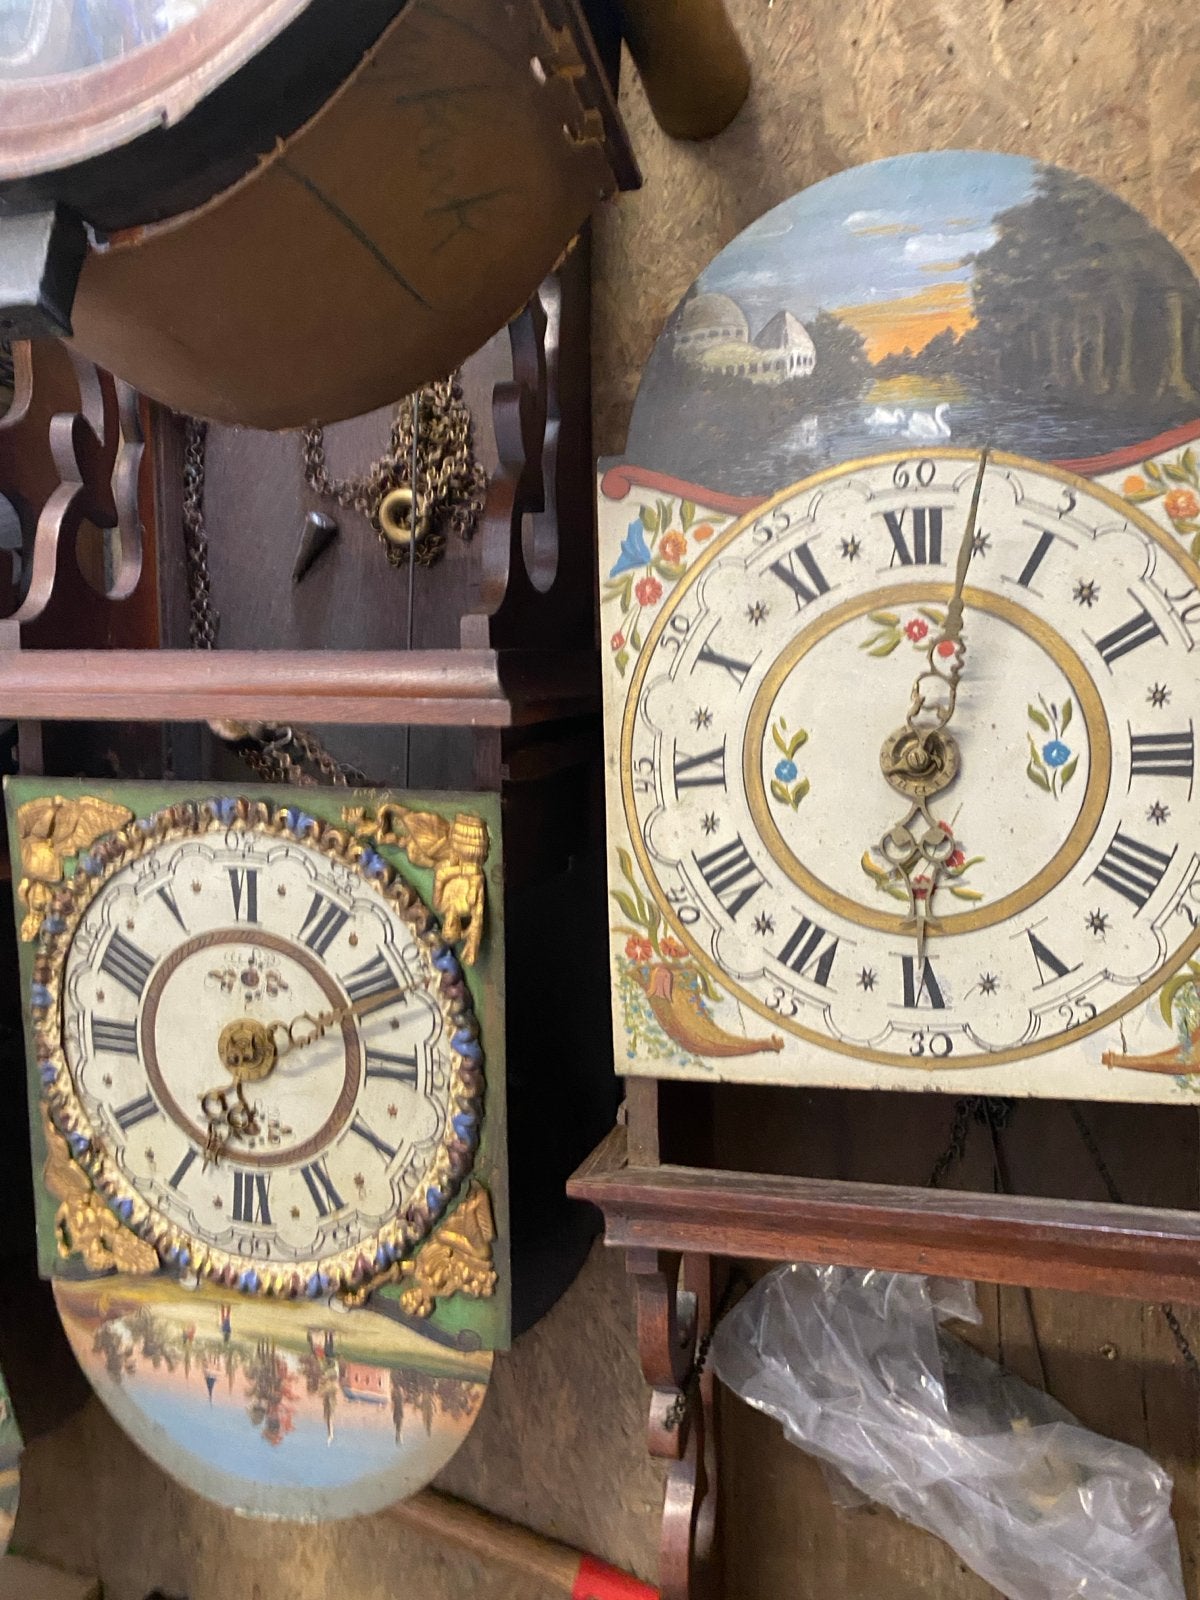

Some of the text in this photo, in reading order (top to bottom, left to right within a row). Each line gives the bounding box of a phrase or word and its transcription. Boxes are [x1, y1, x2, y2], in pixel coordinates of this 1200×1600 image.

[893, 459, 937, 489] 60
[752, 509, 791, 543] 55
[872, 506, 954, 573] XII
[759, 531, 841, 613] XI
[661, 614, 690, 650] 50
[690, 617, 762, 692] X
[1082, 588, 1168, 676] II
[634, 757, 655, 794] 45
[673, 733, 727, 801] IX
[1127, 718, 1194, 802] III
[692, 831, 773, 922] VIII
[764, 906, 857, 994] VII
[1009, 917, 1083, 992] V
[765, 987, 801, 1018] 35
[1058, 998, 1097, 1031] 25
[909, 1030, 953, 1058] 30
[228, 1167, 276, 1229] XII
